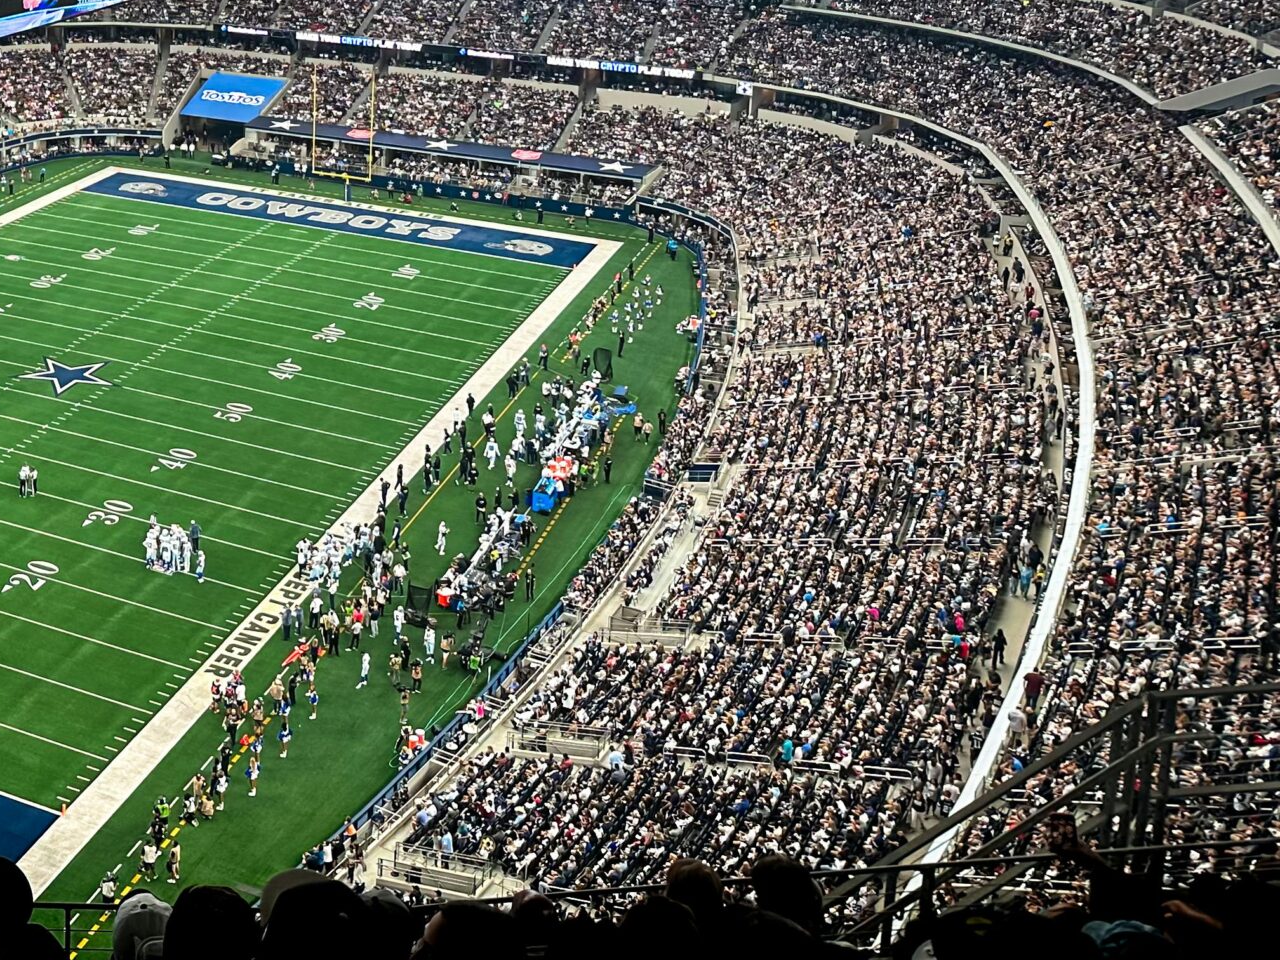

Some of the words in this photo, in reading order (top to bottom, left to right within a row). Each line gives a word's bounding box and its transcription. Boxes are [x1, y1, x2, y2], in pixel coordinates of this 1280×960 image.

[341, 36, 372, 47] CRYPTO
[601, 61, 637, 73] CRYPTO
[195, 192, 462, 241] COWBOYS
[81, 248, 113, 261] 20
[29, 274, 63, 289] 30
[392, 266, 420, 280] 10
[353, 295, 385, 311] 20
[312, 327, 346, 343] 30
[268, 362, 302, 380] 40
[213, 402, 253, 423] 50
[158, 448, 197, 470] 40
[87, 499, 134, 525] 30
[9, 560, 60, 591] 20
[204, 612, 280, 677] CANCER
